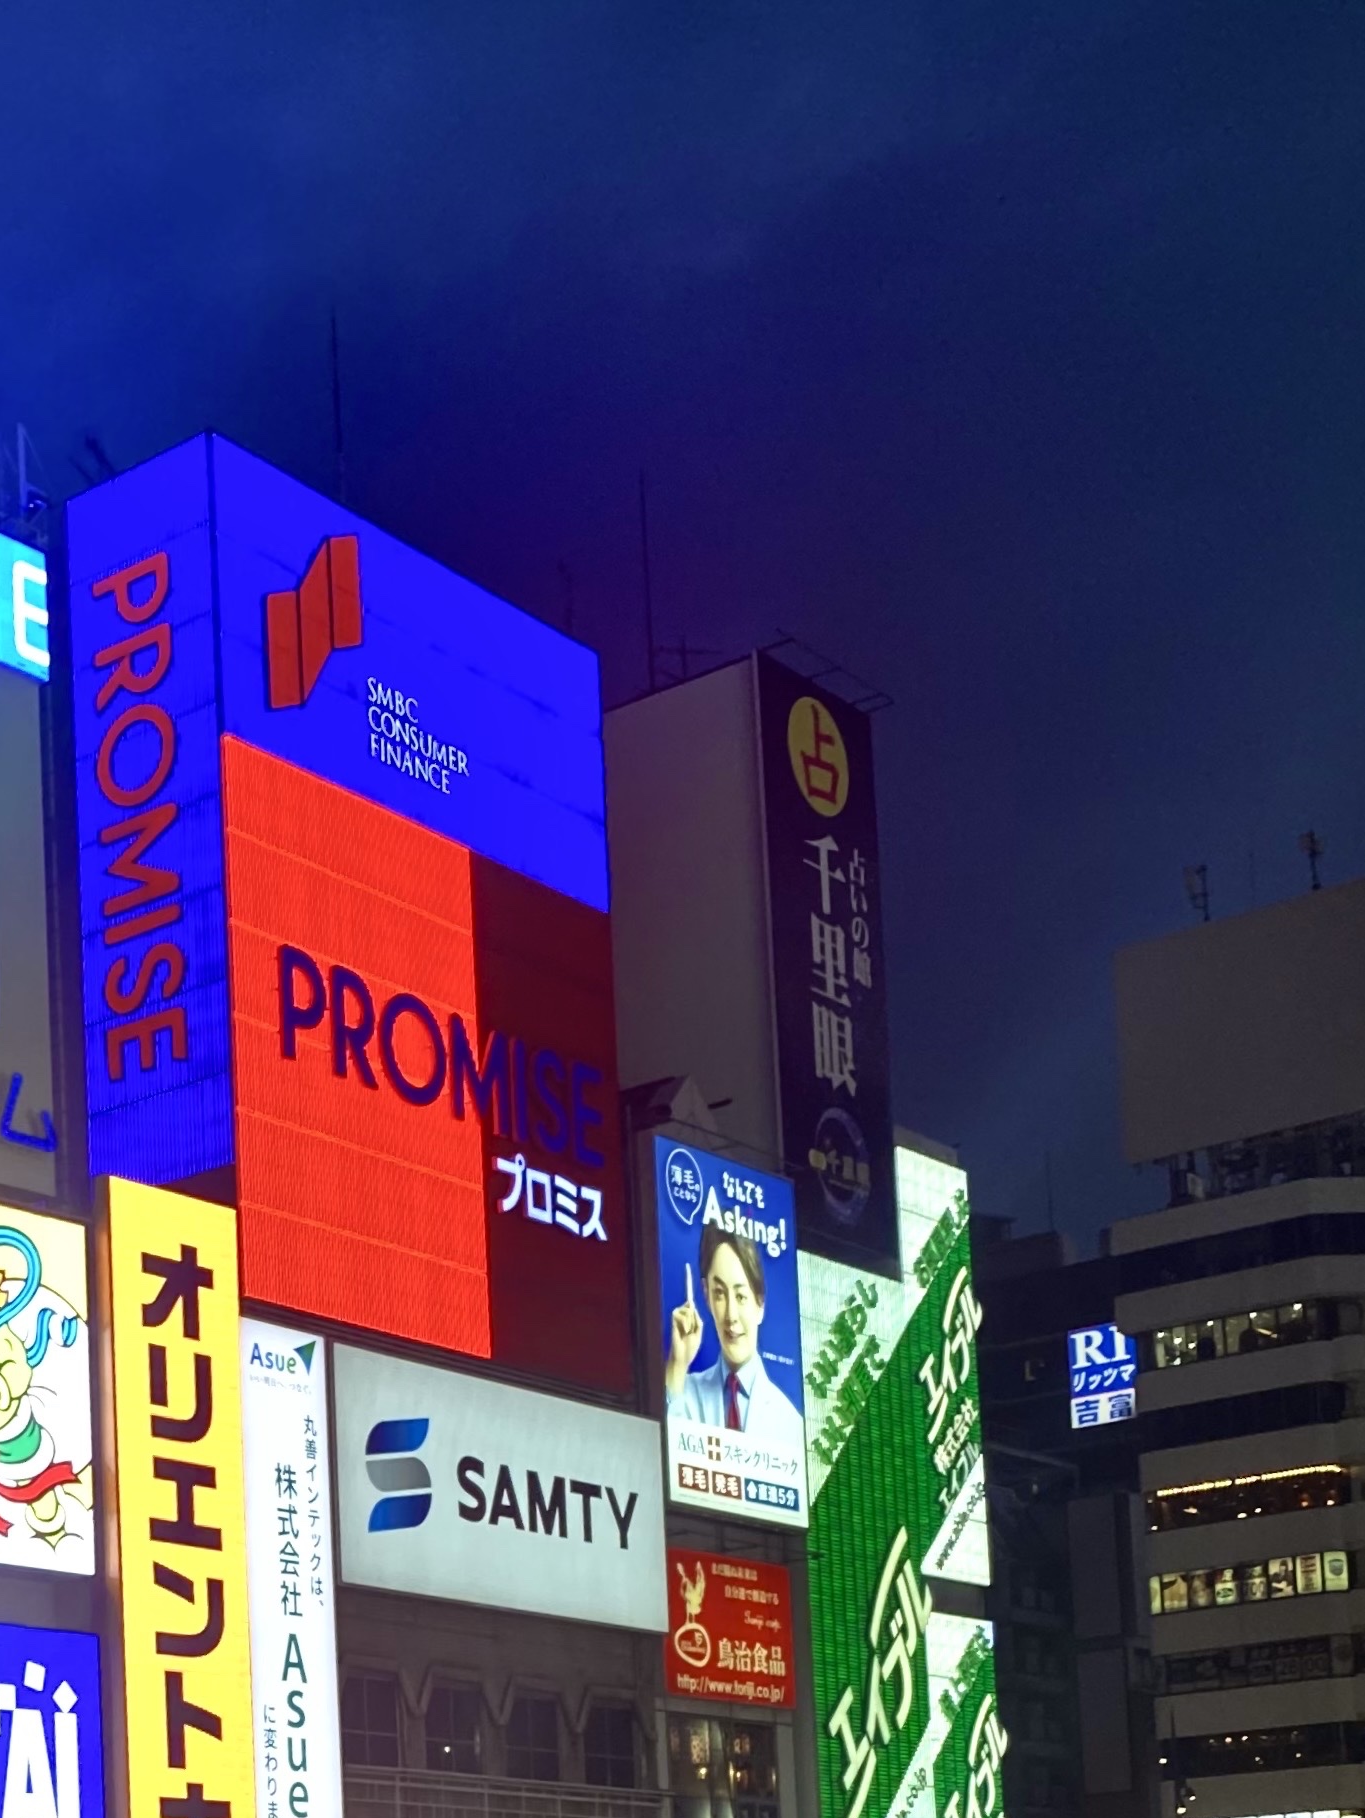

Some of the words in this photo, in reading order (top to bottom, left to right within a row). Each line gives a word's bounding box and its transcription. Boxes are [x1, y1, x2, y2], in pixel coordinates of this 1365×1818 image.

[368, 676, 419, 723] SMBC
[367, 707, 469, 776] CONSUMER
[369, 734, 451, 795] FINANCE
[800, 703, 839, 806] 占
[92, 552, 188, 1081] PROMISE
[802, 833, 857, 1098] 千里眼
[277, 944, 605, 1167] PROMISE
[494, 1153, 608, 1242] プロミス
[701, 1185, 787, 1258] Asking!
[722, 1170, 765, 1209] なんでも
[249, 1342, 297, 1374] Asue
[677, 1432, 707, 1456] AGA
[1075, 1393, 1133, 1426] 吉富
[724, 1444, 798, 1476] スキンクリニック
[274, 1460, 304, 1618] 株式会社
[303, 1414, 324, 1608] 丸善インテックは、
[456, 1455, 639, 1551] SAMTY
[829, 1560, 933, 1791] エイブル
